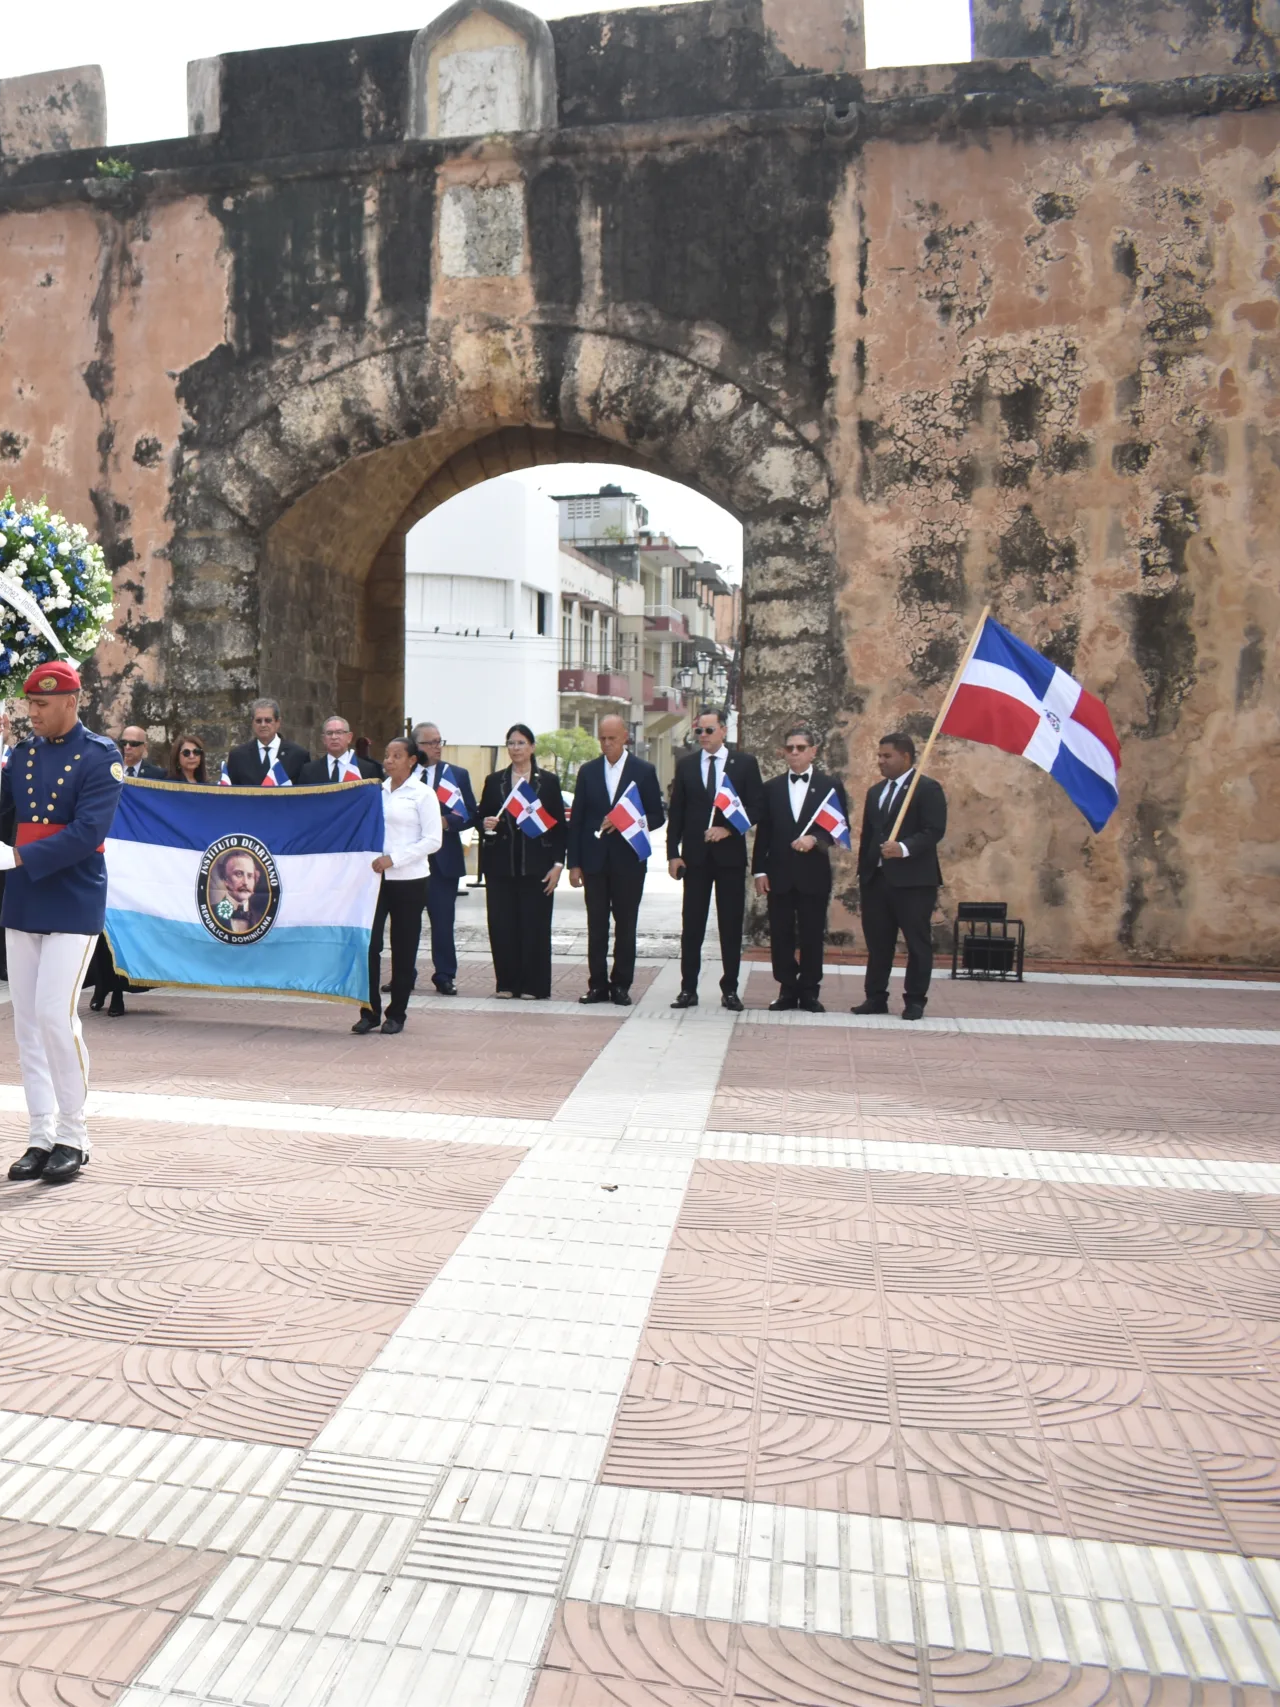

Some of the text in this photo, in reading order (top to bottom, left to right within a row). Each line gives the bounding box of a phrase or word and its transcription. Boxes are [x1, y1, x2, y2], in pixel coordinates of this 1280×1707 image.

[201, 837, 278, 887] INSTITUTO DUARTIANO
[200, 904, 272, 943] REPUBLICA DOMINICANA
